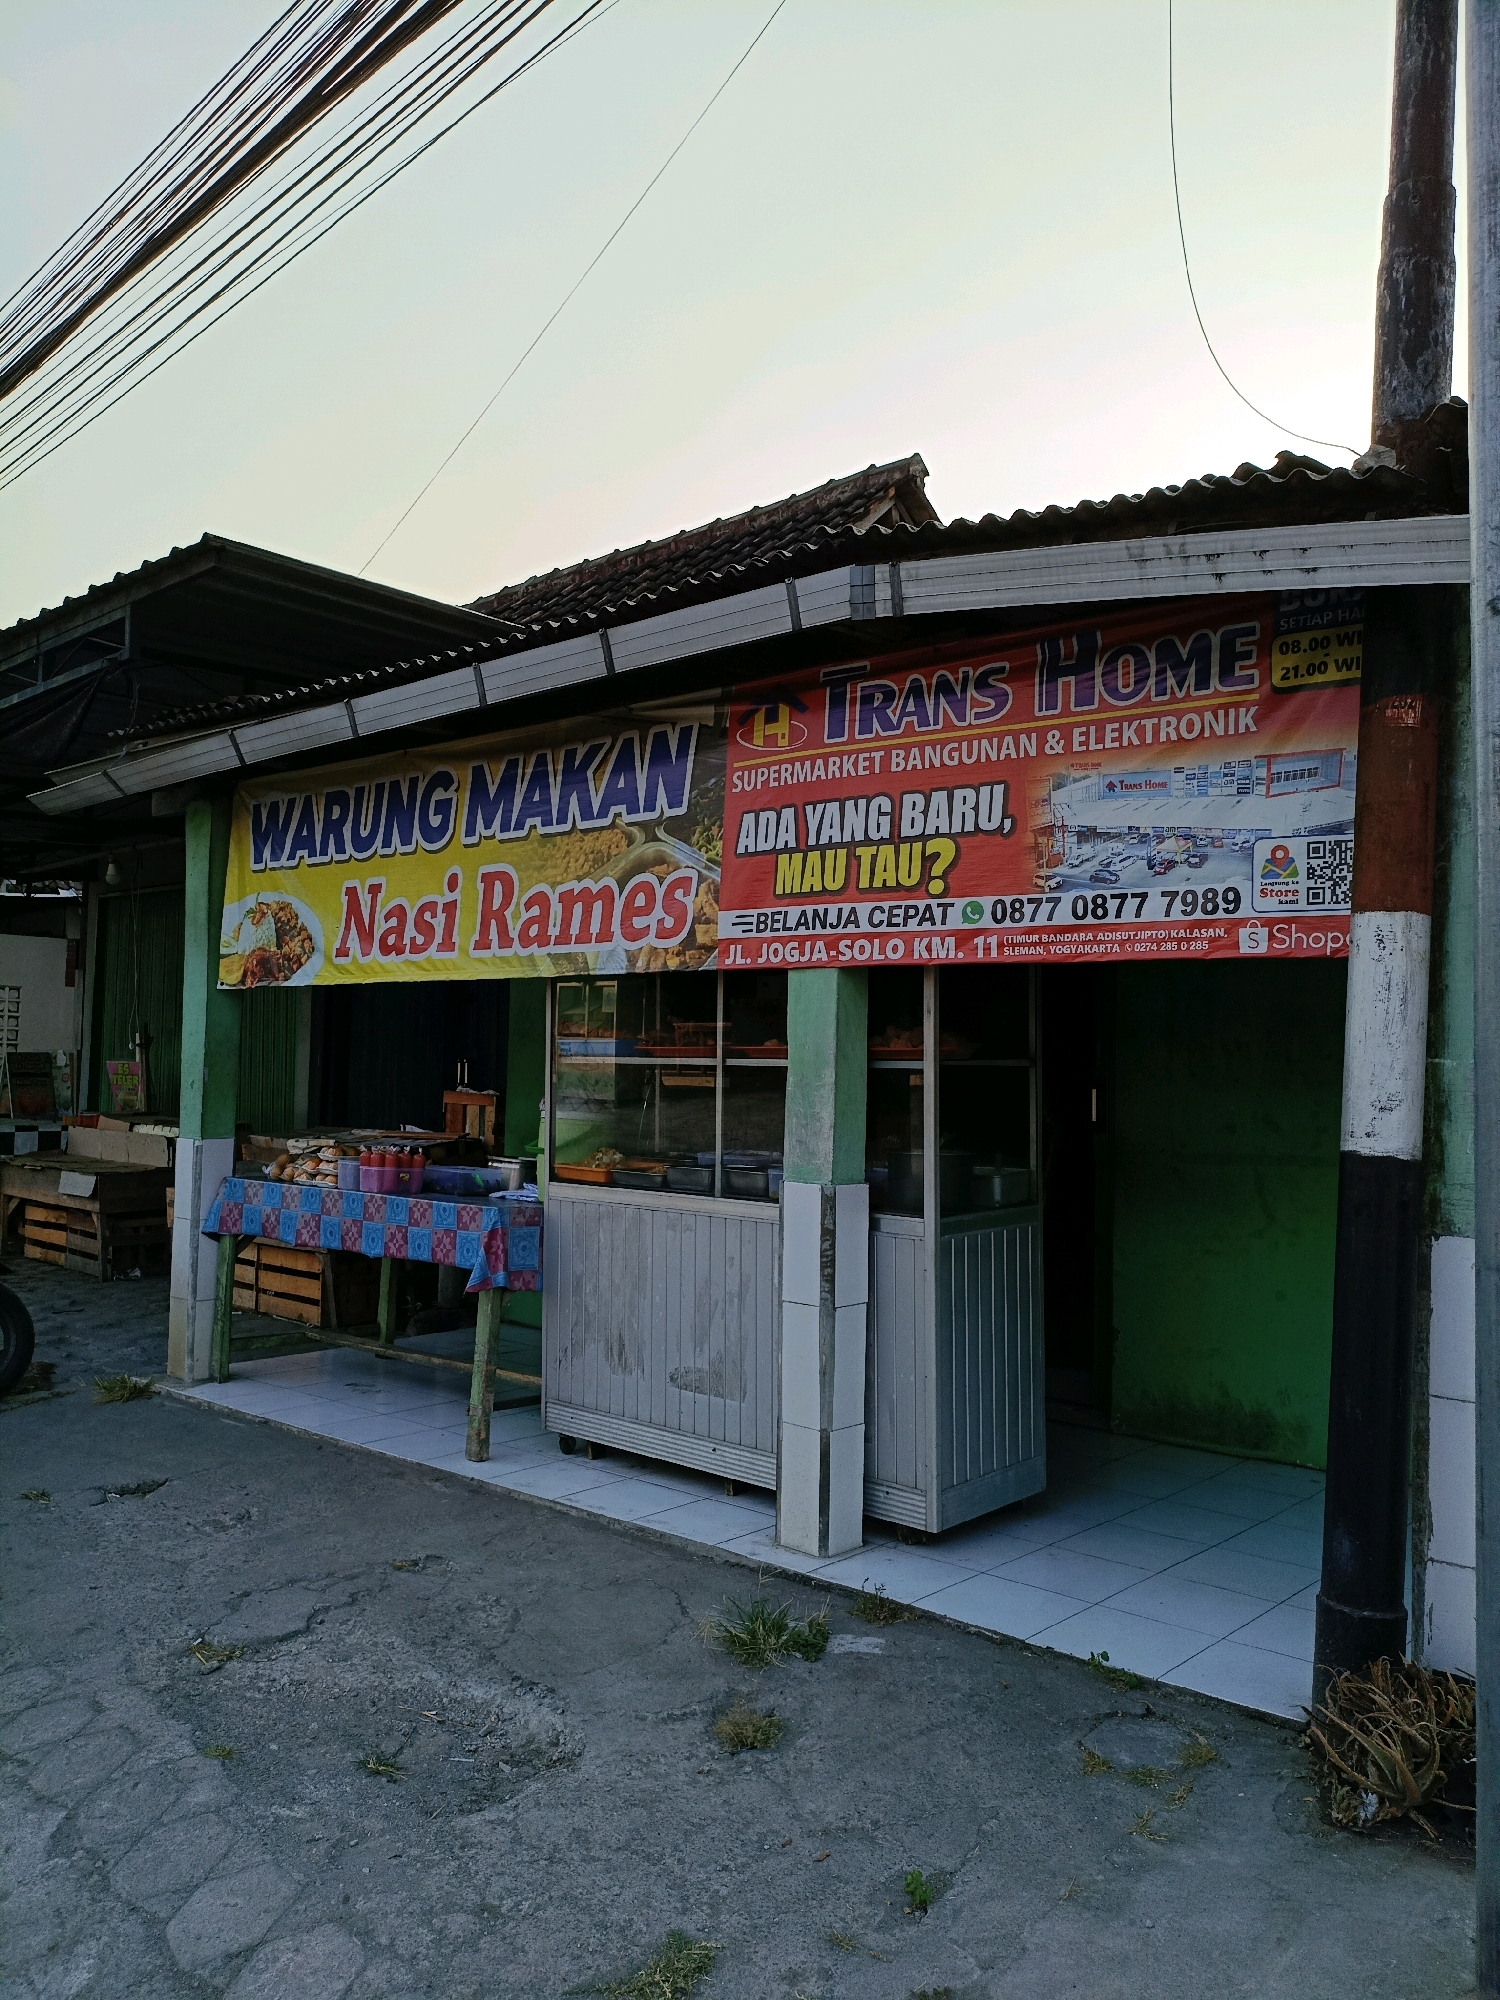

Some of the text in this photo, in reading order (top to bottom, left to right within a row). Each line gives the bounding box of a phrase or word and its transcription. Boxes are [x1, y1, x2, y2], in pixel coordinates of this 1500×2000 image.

[1279, 606, 1365, 631] SETIAP HA
[1278, 629, 1362, 655] 08.00 WI
[820, 621, 1260, 743] TRANS HOME
[1280, 656, 1361, 681] 21.00 WI
[731, 705, 1259, 793] SUPERMARKET BANGUNAN & ELEKTRONIK
[251, 722, 699, 869] WARUNG MAKAN
[1119, 780, 1168, 791] TRANS HOME
[736, 807, 797, 854] ADA
[804, 796, 892, 846] YANG
[900, 784, 1012, 837] BARU,
[775, 837, 956, 895] MAU TAU?
[1259, 888, 1299, 898] Store
[333, 866, 698, 961] Nasi Rames
[755, 886, 1242, 933] BELANJA CEPAT 0877 0877 7989
[725, 934, 998, 965] JL. JOGJA-SOLO KM. 11
[1003, 934, 1040, 944] (TIMUR
[1041, 932, 1093, 943] BANDARA
[1096, 929, 1169, 942] ADISUTJIPTO)
[1003, 940, 1209, 956] SLEMAN, YOGYAKARTA 0274 285 0 285
[1272, 923, 1351, 956] Shop
[111, 1074, 139, 1085] TELER
[117, 1063, 129, 1074] ES
